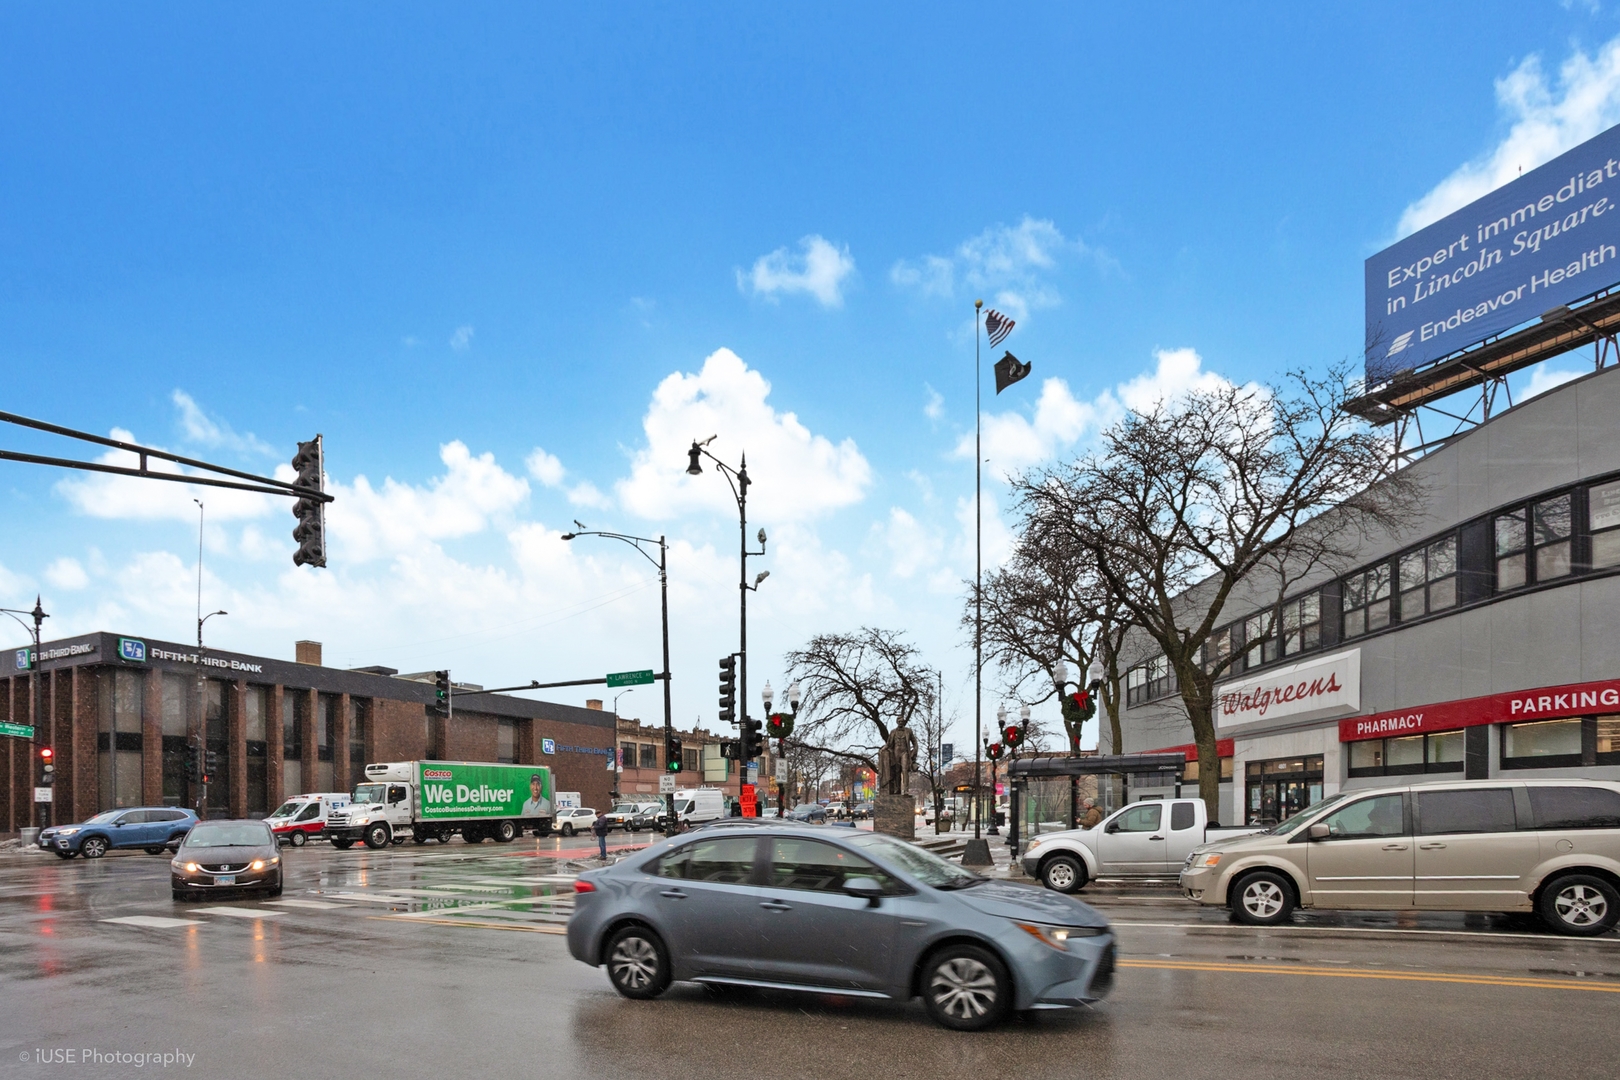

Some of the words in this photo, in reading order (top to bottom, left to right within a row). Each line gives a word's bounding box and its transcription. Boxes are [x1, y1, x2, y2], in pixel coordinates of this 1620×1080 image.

[1388, 234, 1469, 288] Expert
[1477, 158, 1620, 243] immediat
[1387, 296, 1406, 315] in
[1412, 248, 1503, 304] Lincoln
[1510, 197, 1615, 257] Square.
[1421, 284, 1527, 342] Endeavor
[1531, 244, 1616, 294] Health
[31, 652, 49, 662] FITH
[49, 647, 70, 659] THIRD
[70, 643, 90, 655] BANK
[151, 647, 187, 662] FIFTH
[190, 653, 228, 668] THIRD
[230, 660, 262, 673] BANK
[614, 672, 643, 681] LAWRENCE
[1221, 672, 1342, 716] Walgreens
[1511, 688, 1620, 715] PARKING
[1357, 713, 1424, 735] PHARMACY
[574, 745, 592, 754] THIRD
[424, 769, 452, 777] COSTCO
[424, 784, 453, 803] We
[456, 784, 514, 803] Deliver
[425, 806, 504, 814] CostcoBusinessDelivery.com
